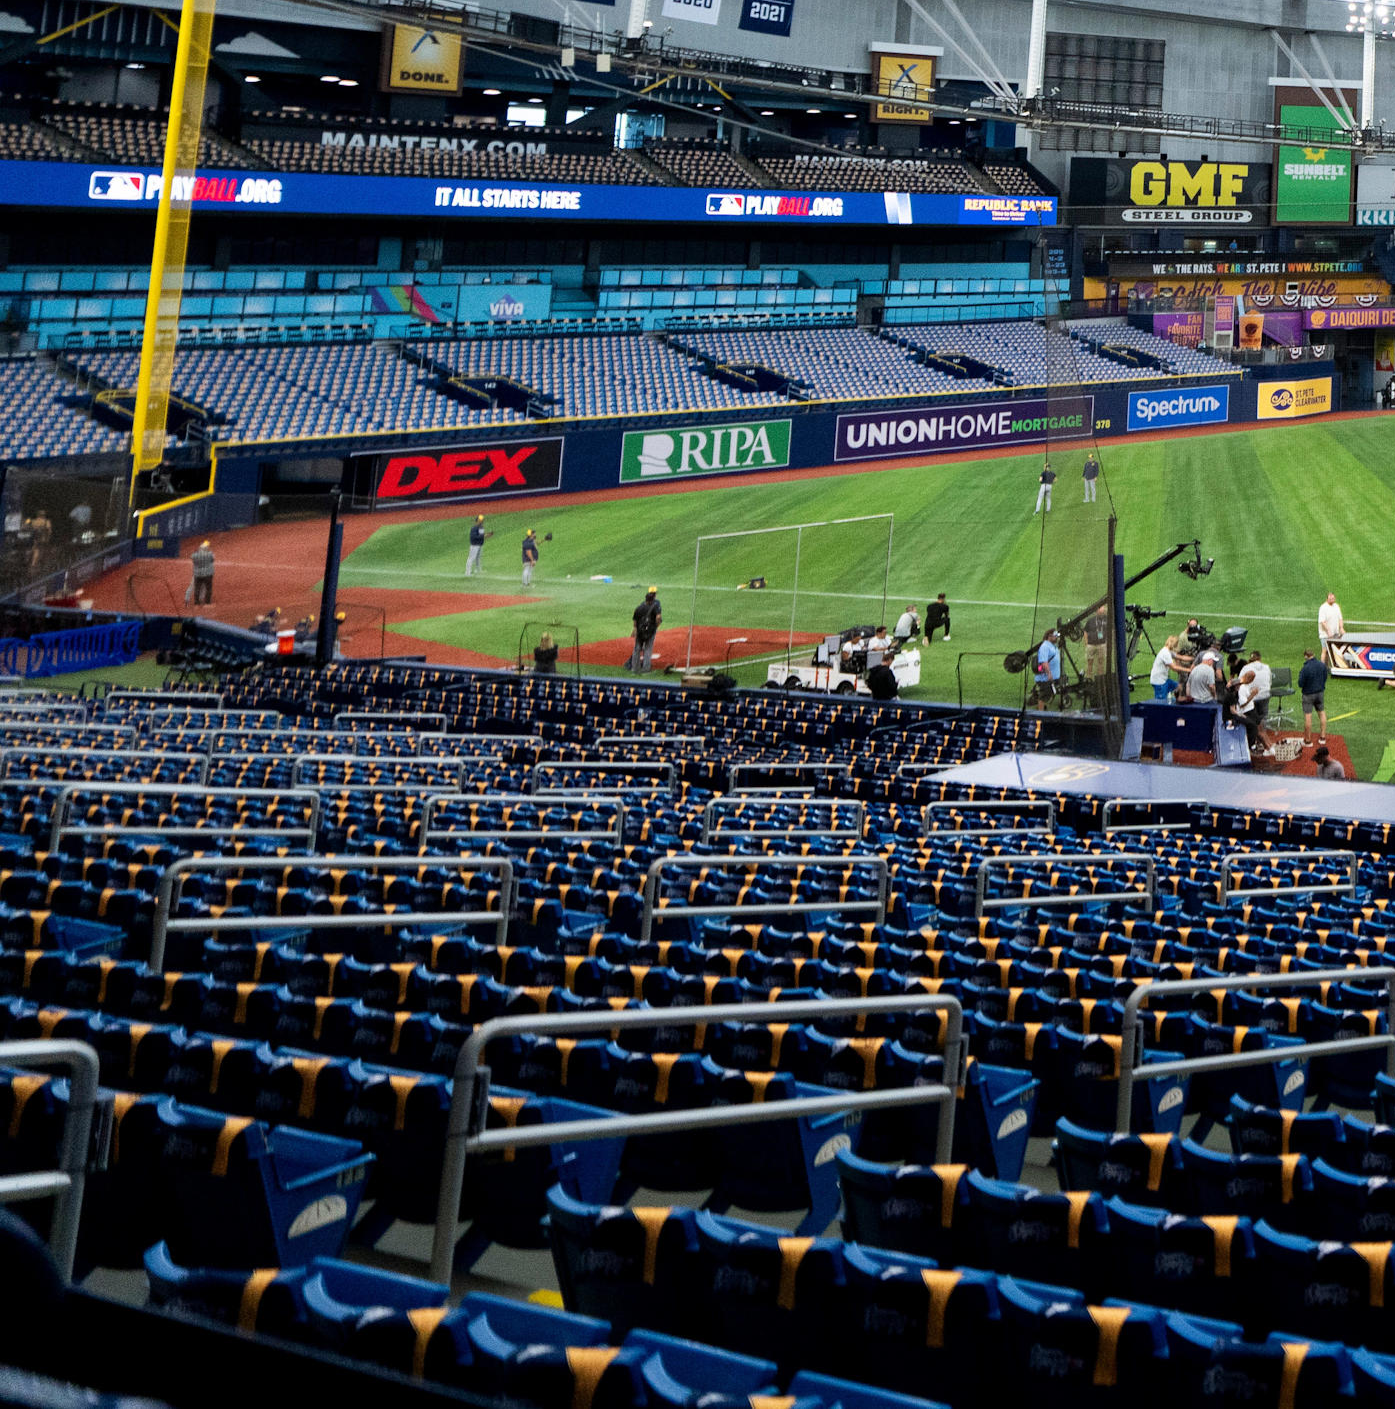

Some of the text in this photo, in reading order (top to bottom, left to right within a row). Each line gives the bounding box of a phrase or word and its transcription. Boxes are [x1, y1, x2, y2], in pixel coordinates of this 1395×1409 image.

[749, 2, 785, 23] 2021
[400, 71, 450, 84] DONE.
[882, 104, 925, 116] RIGHT.
[1129, 161, 1249, 207] GMF
[435, 187, 582, 210] IT ALL STARTS HERE
[745, 195, 844, 217] PLAYBALL.ORG
[964, 199, 1054, 212] REPUBLIC BANK
[1131, 211, 1244, 221] STEEL GROUP
[1152, 263, 1166, 274] WE
[1175, 263, 1191, 274] THE
[1192, 263, 1216, 274] RAYS.
[1216, 263, 1229, 273] WE
[1287, 262, 1363, 273] WWW.STPETE.ORG
[1187, 314, 1202, 324] FAN
[1329, 310, 1381, 327] DAIQUIRI
[1136, 395, 1215, 422] Spectrum
[1295, 394, 1326, 408] CLEARWATER
[1010, 414, 1083, 433] MORTGAGE
[1095, 419, 1111, 429] 378
[676, 425, 777, 473] RIPA
[376, 446, 539, 498] DEX
